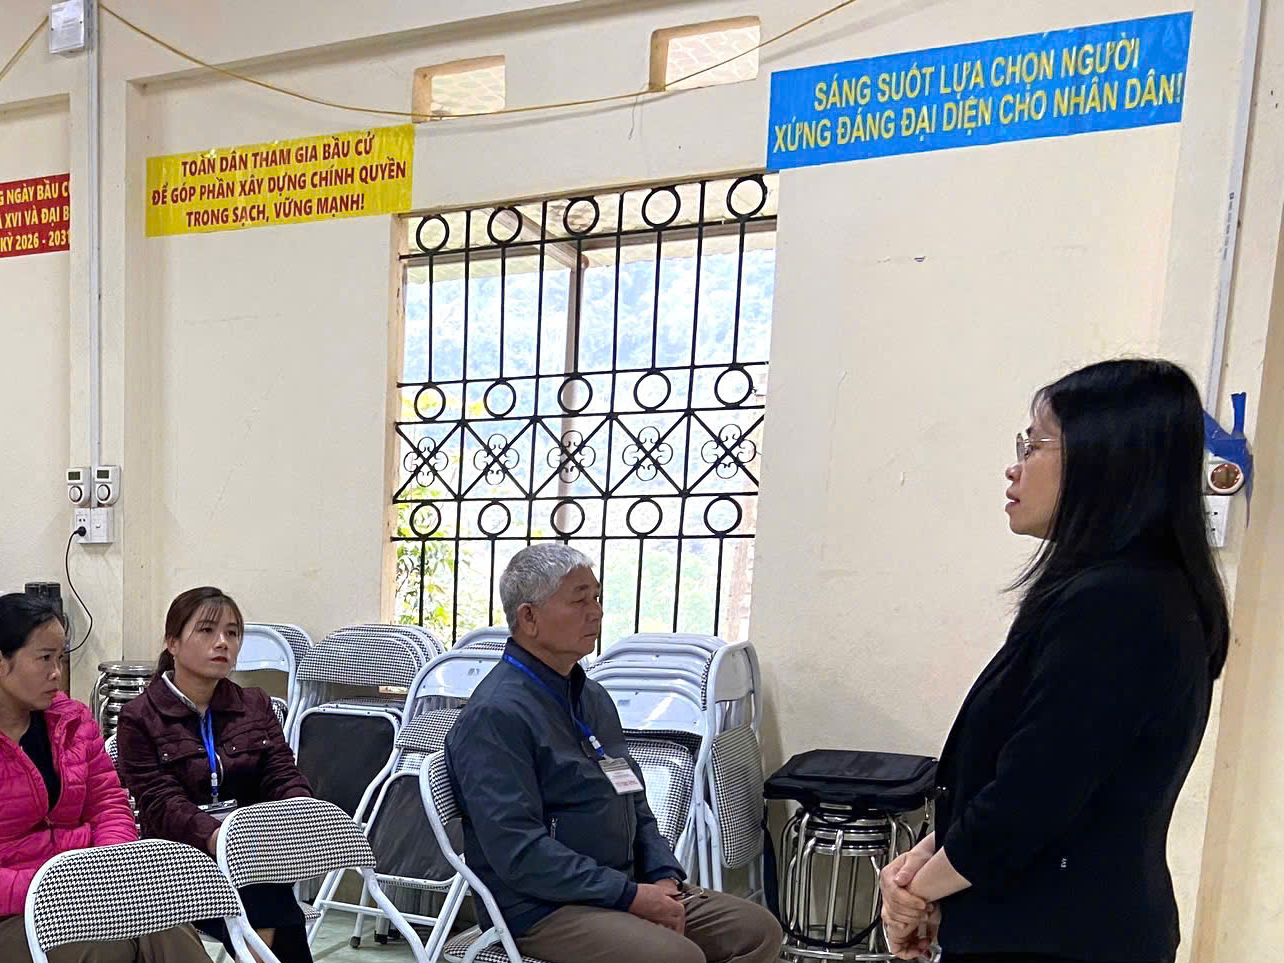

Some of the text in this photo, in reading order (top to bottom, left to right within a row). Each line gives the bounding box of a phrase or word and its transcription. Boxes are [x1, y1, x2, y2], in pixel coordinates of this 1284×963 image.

[814, 73, 871, 111] SÁNG
[940, 60, 985, 99] LỰA
[991, 48, 1054, 90] CHỌN
[1061, 32, 1140, 78] NGƯỜI
[773, 67, 1183, 153] XỨNG ĐÁNG ĐẠI DIỆN CHO NHÂN DÂN!
[181, 131, 374, 177] TOÀN DÂN THAM GIA BẦU CỬ
[6, 183, 34, 205] NGÀY
[37, 179, 59, 200] BẦU
[152, 156, 406, 206] ĐỂ GÓP PHẦN XÂY DỰNG CHÍNH QUYỀN
[5, 211, 21, 229] XVI
[24, 205, 38, 226] VÀ
[41, 206, 60, 227] ĐẠI
[186, 193, 364, 227] TRONG SẠCH, VỮNG MẠNH!
[0, 231, 13, 252] KỲ
[15, 233, 39, 250] 2026
